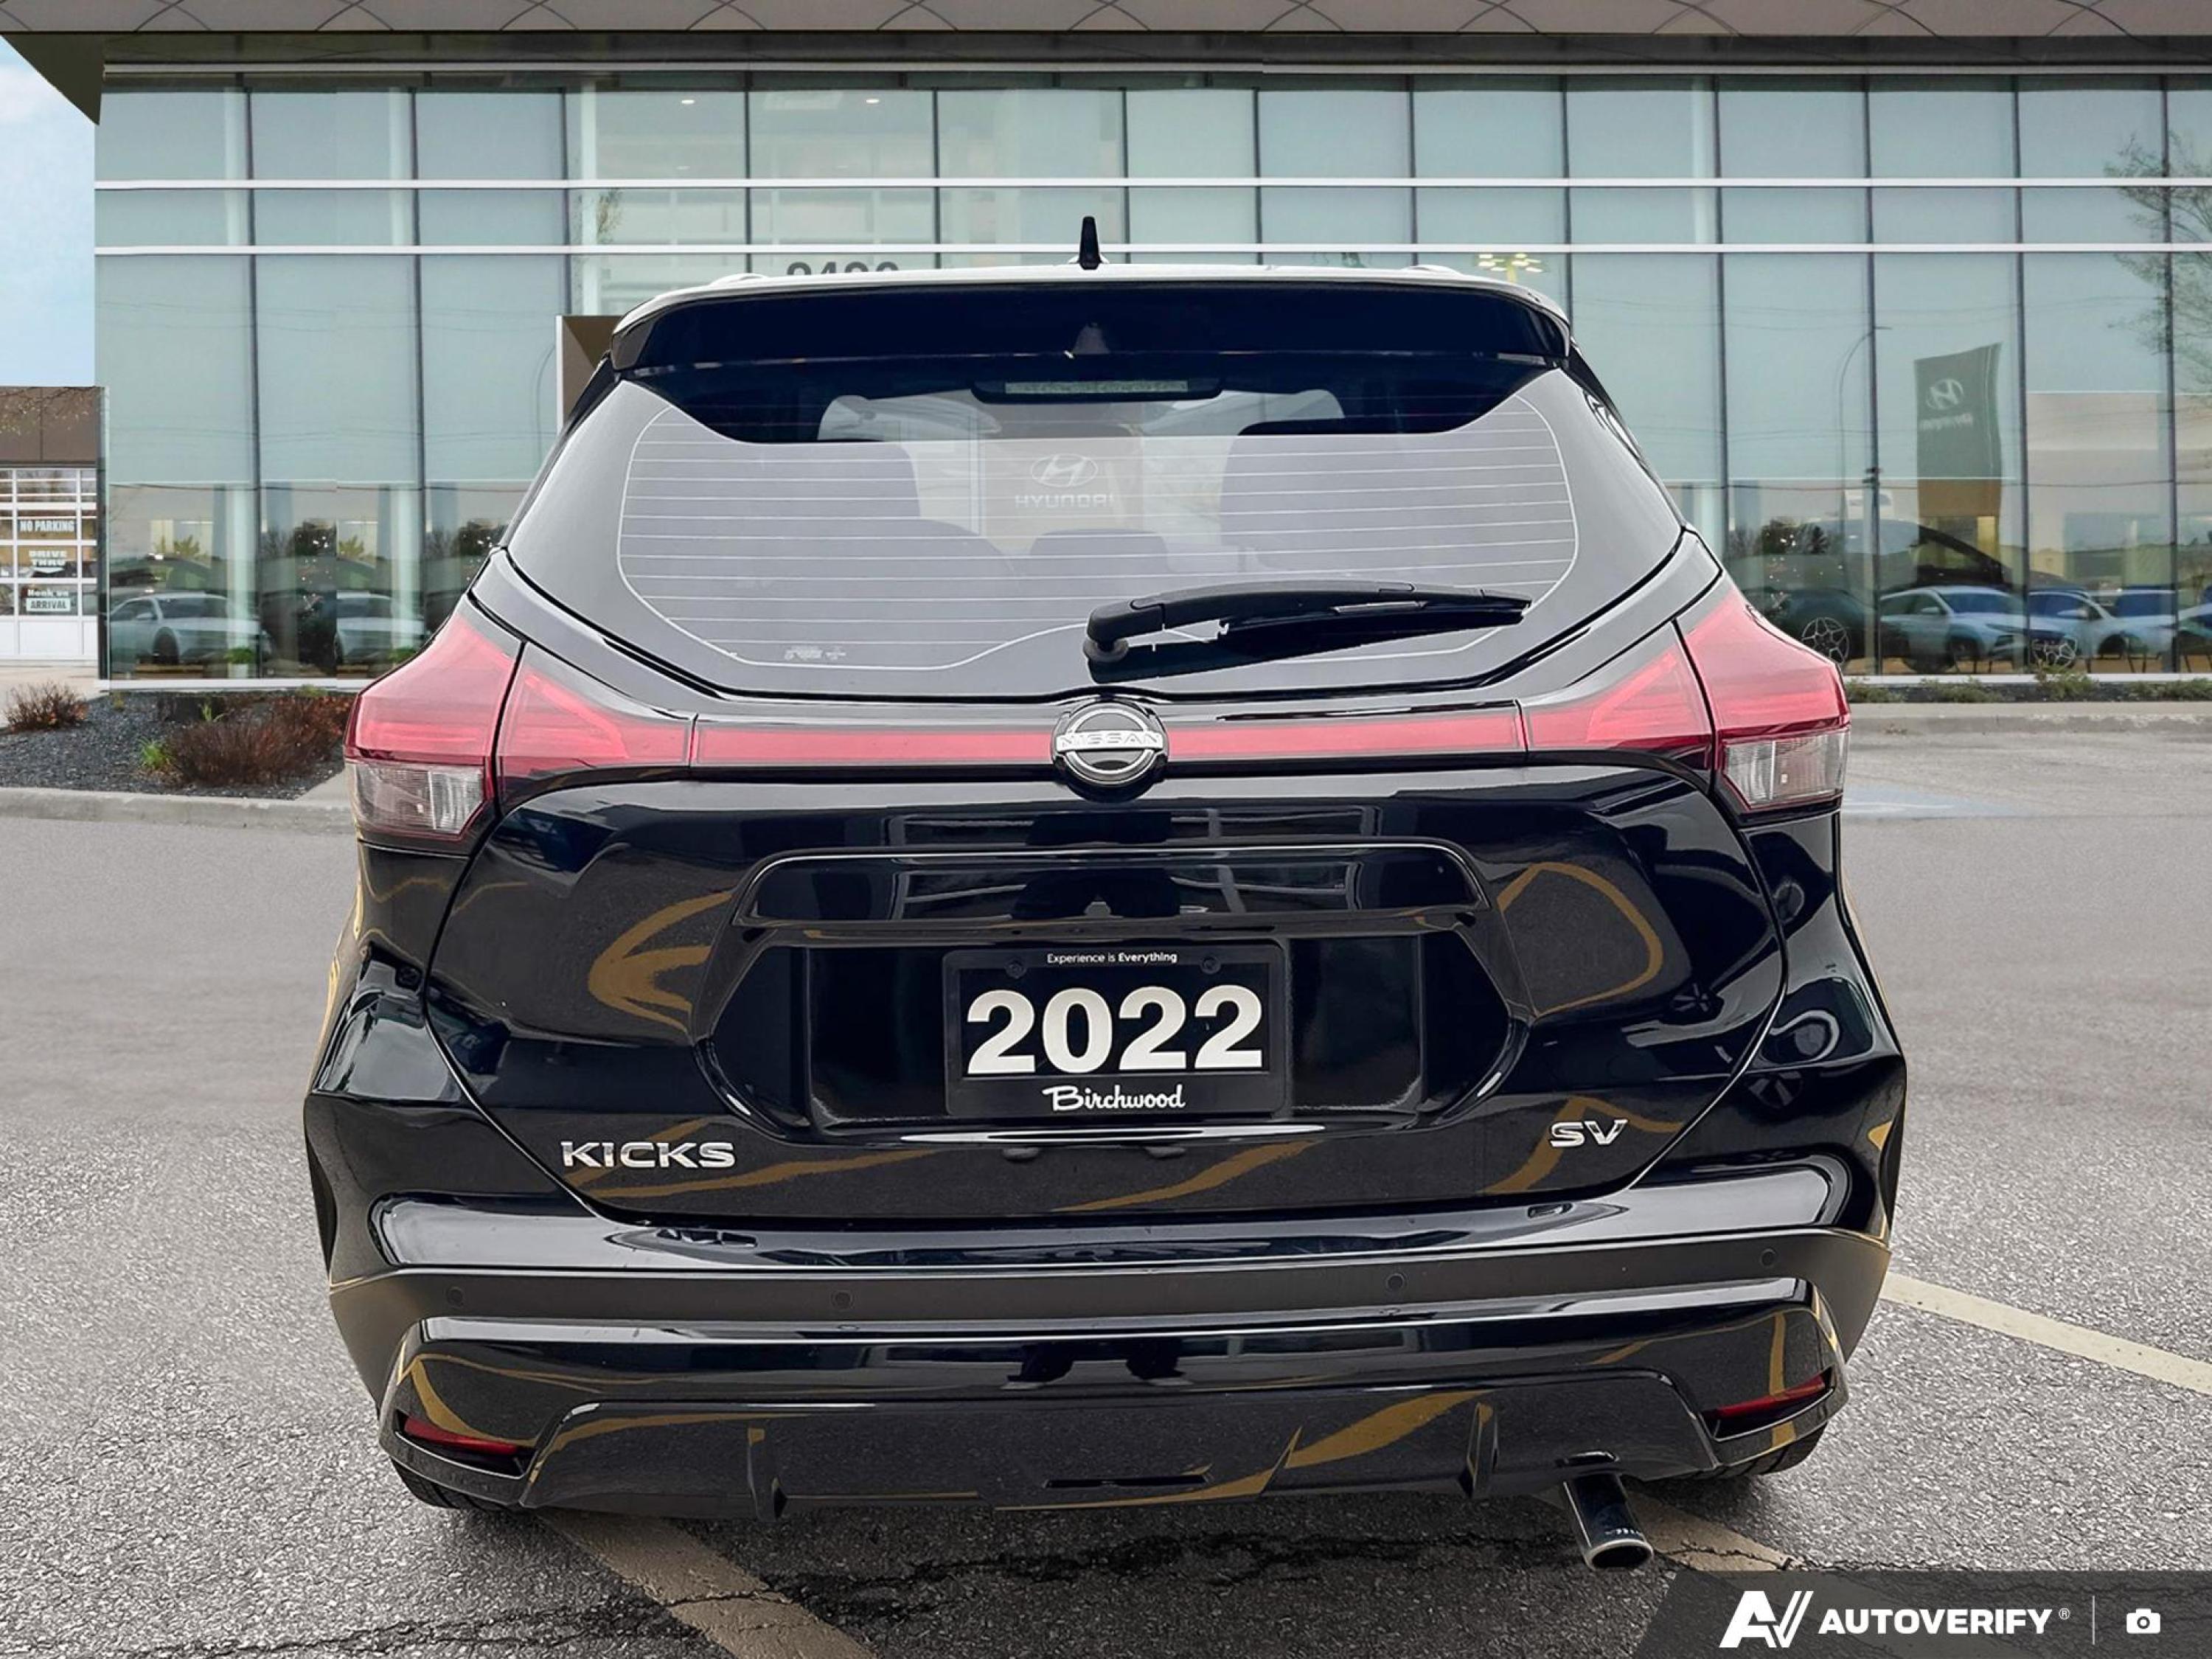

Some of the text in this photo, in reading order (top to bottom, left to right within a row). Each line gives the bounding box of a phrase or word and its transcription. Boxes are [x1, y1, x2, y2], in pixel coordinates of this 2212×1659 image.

[20, 520, 74, 532] NO PARKING
[30, 599, 68, 609] ARRIVAL
[1060, 732, 1161, 748] NISSAN
[1046, 952, 1178, 964] Experience is Everything
[967, 984, 1263, 1074] 2022
[1042, 1084, 1186, 1111] Birchwood
[1550, 1119, 1629, 1147] SV
[560, 1141, 736, 1169] KICKS
